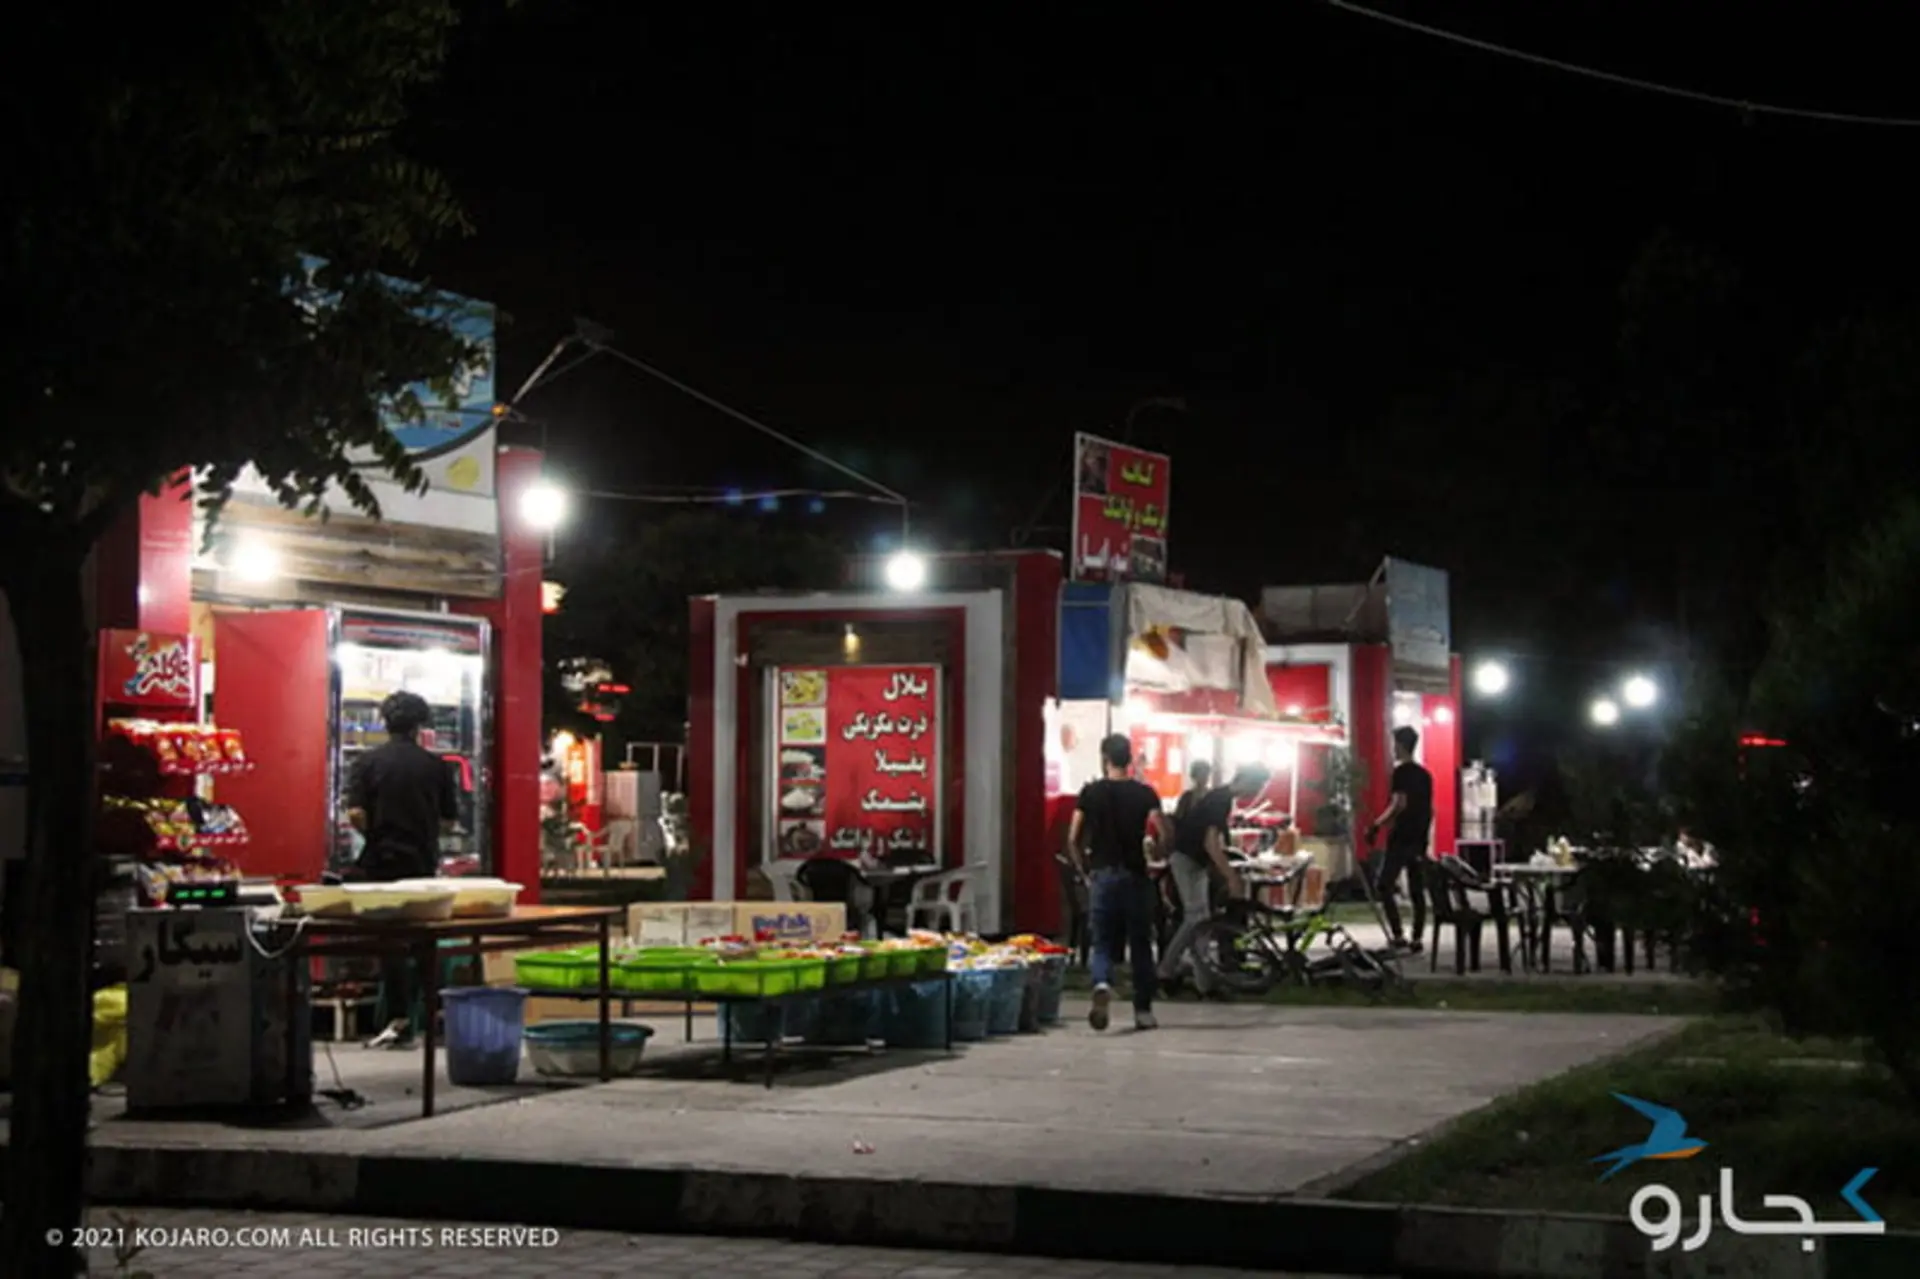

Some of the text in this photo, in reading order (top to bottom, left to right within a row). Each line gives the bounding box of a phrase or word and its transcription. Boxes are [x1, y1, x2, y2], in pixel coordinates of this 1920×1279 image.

[883, 673, 928, 700] بلال
[896, 710, 928, 740] ذرت
[860, 789, 927, 817] پشمک
